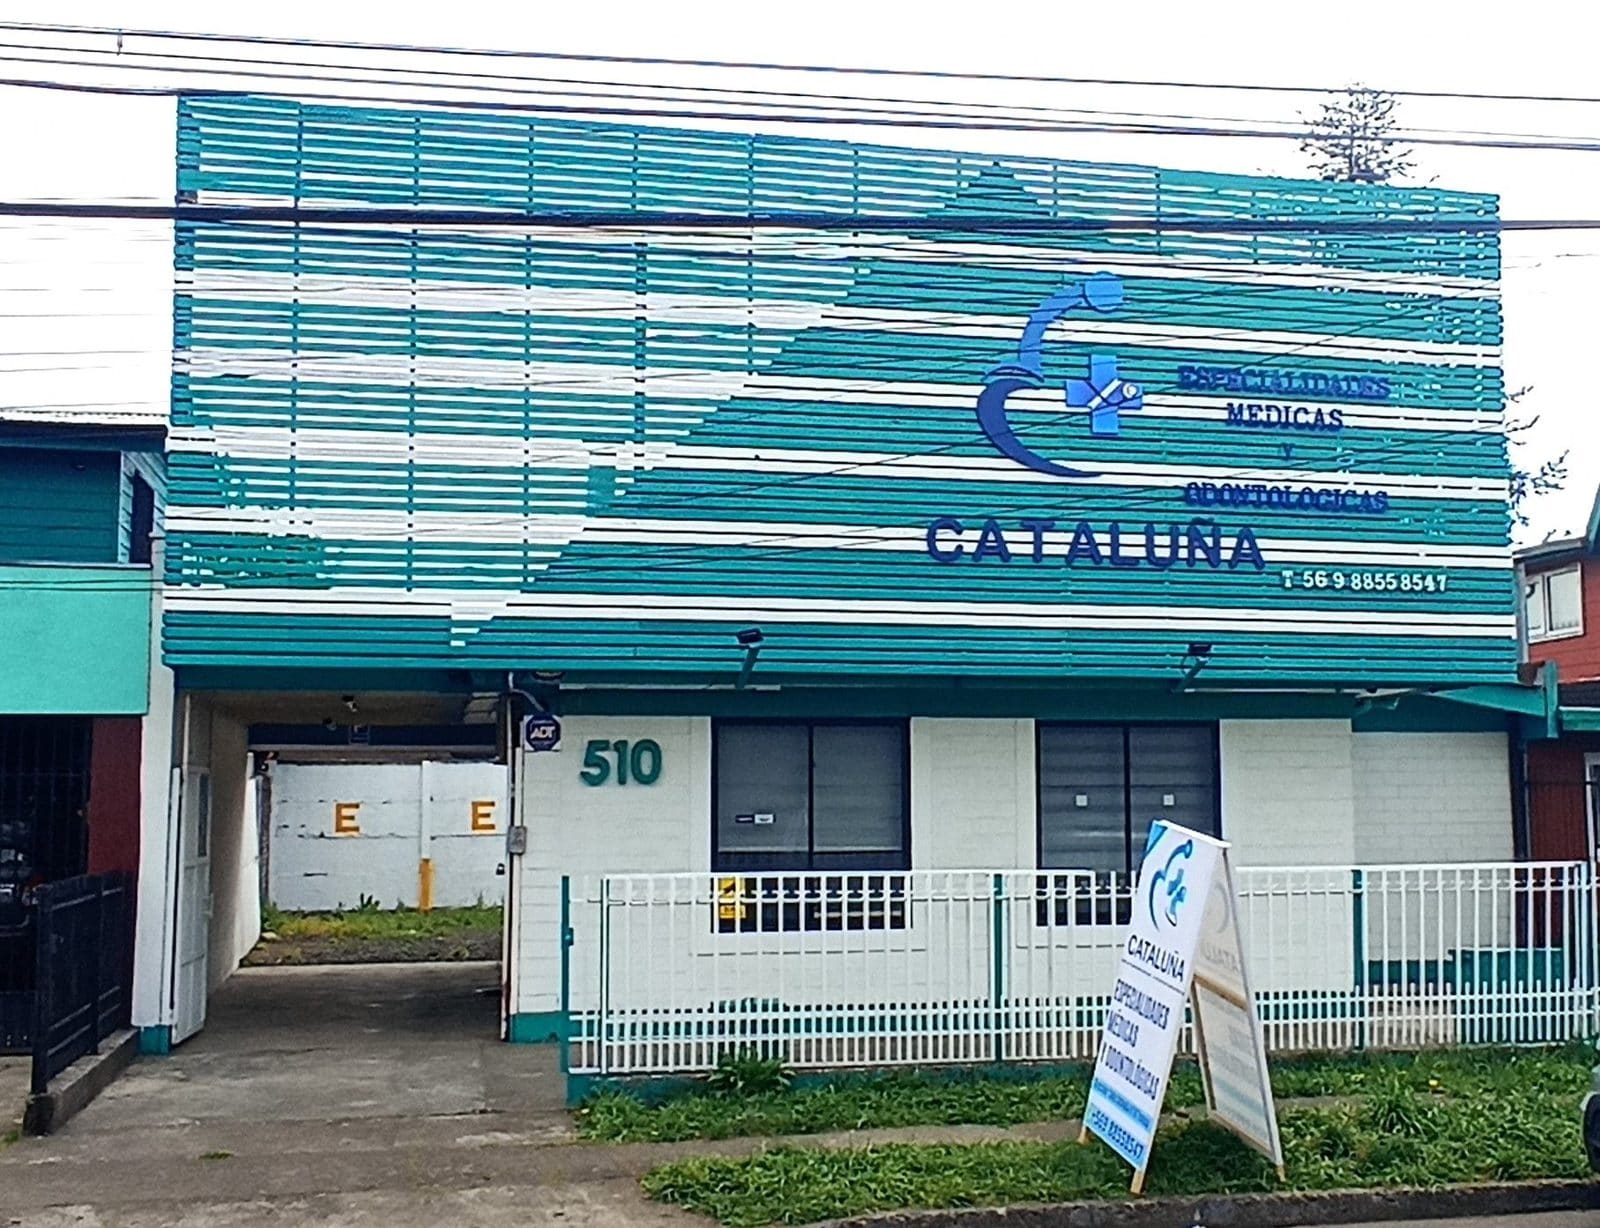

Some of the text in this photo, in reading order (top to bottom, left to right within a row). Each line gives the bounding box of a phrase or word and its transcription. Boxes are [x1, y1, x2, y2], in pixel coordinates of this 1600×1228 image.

[1177, 365, 1391, 399] ESPECIALIDADES
[1226, 402, 1344, 431] MEDICAS
[1281, 443, 1295, 461] Y
[1184, 481, 1389, 513] ODONTOLOGICAS
[926, 516, 1266, 571] CATALUÑA
[1282, 570, 1447, 592] T 56 9 8855 8547
[530, 726, 556, 739] ADT
[580, 738, 662, 787] 510
[335, 802, 360, 833] E
[471, 801, 496, 830] E
[1127, 934, 1185, 982] CATALUÑA
